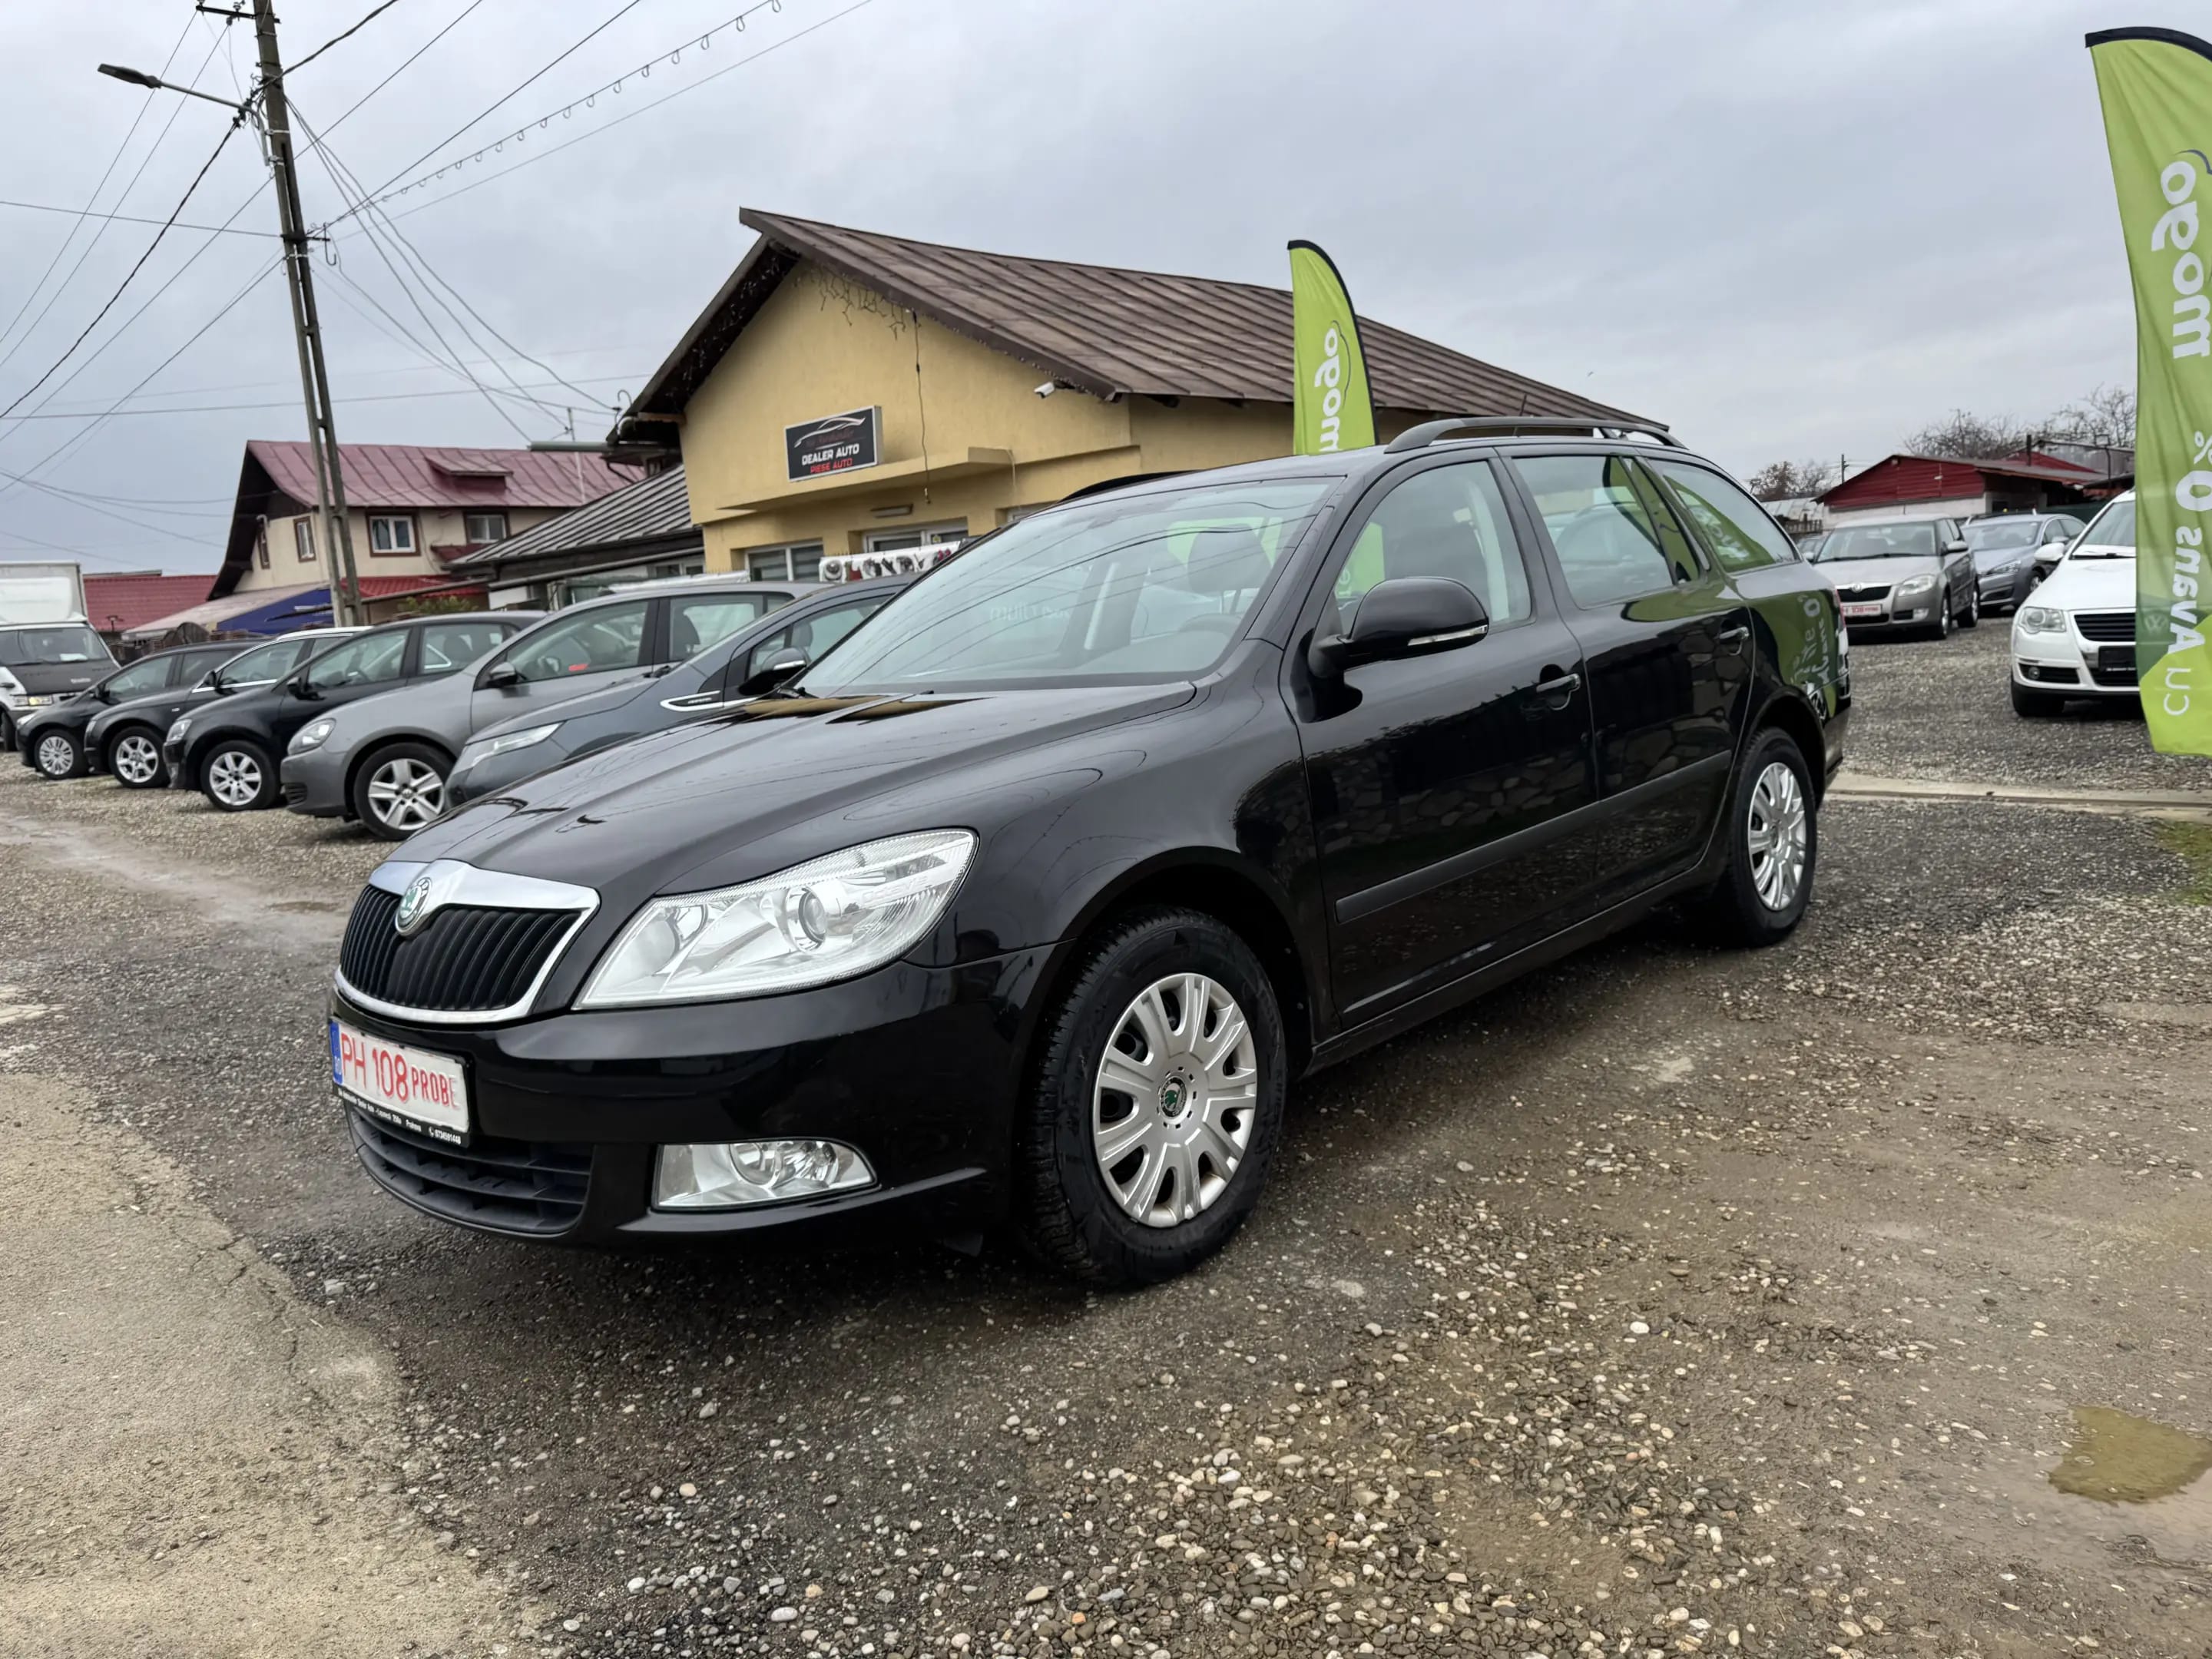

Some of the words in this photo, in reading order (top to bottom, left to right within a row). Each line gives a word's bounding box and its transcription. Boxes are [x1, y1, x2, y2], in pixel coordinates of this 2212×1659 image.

[802, 449, 834, 465] DEALER
[836, 443, 859, 459] AUTO
[833, 457, 853, 470] AUTO
[341, 1031, 366, 1089] PH
[372, 1047, 409, 1102] 108
[411, 1066, 461, 1111] PROBE
